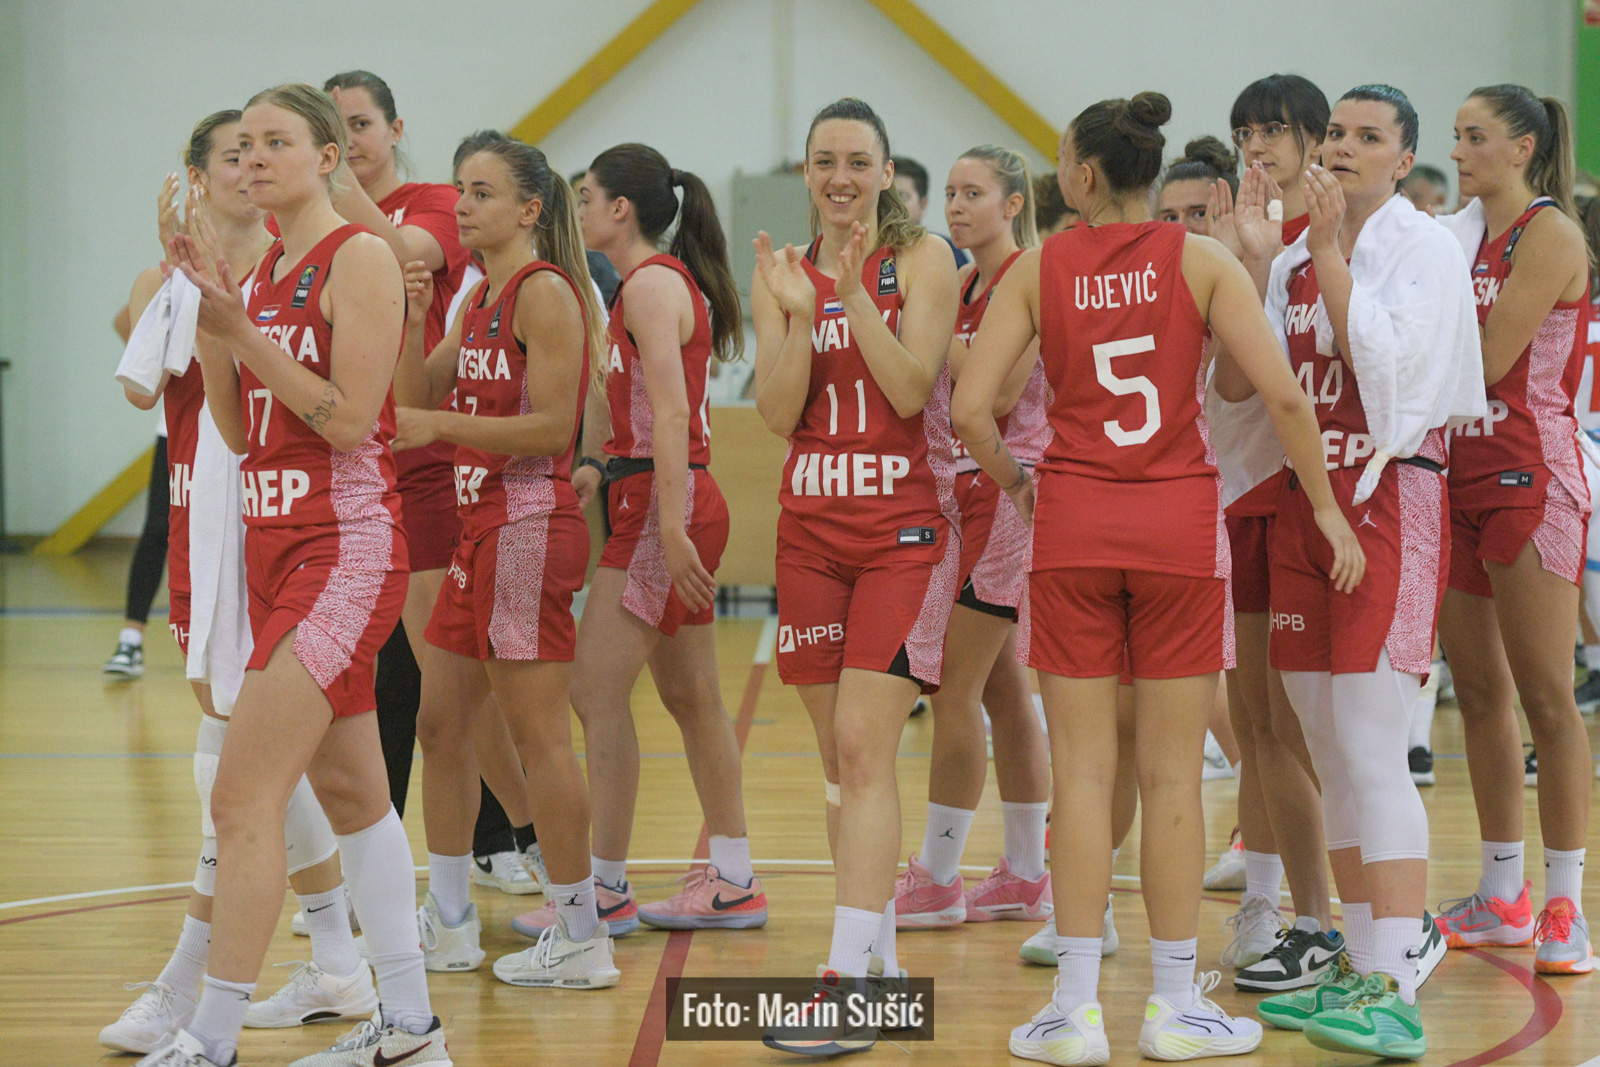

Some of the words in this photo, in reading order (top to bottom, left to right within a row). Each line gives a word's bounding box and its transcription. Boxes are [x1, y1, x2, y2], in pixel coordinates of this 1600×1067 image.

[1075, 262, 1158, 310] UJEVIĆ
[826, 379, 867, 435] 11
[1092, 334, 1162, 447] 5
[1297, 359, 1344, 411] 44
[248, 388, 273, 447] 17
[925, 531, 931, 539] S
[448, 560, 467, 589] HPB
[796, 622, 845, 647] HPB
[1271, 611, 1306, 632] HPB
